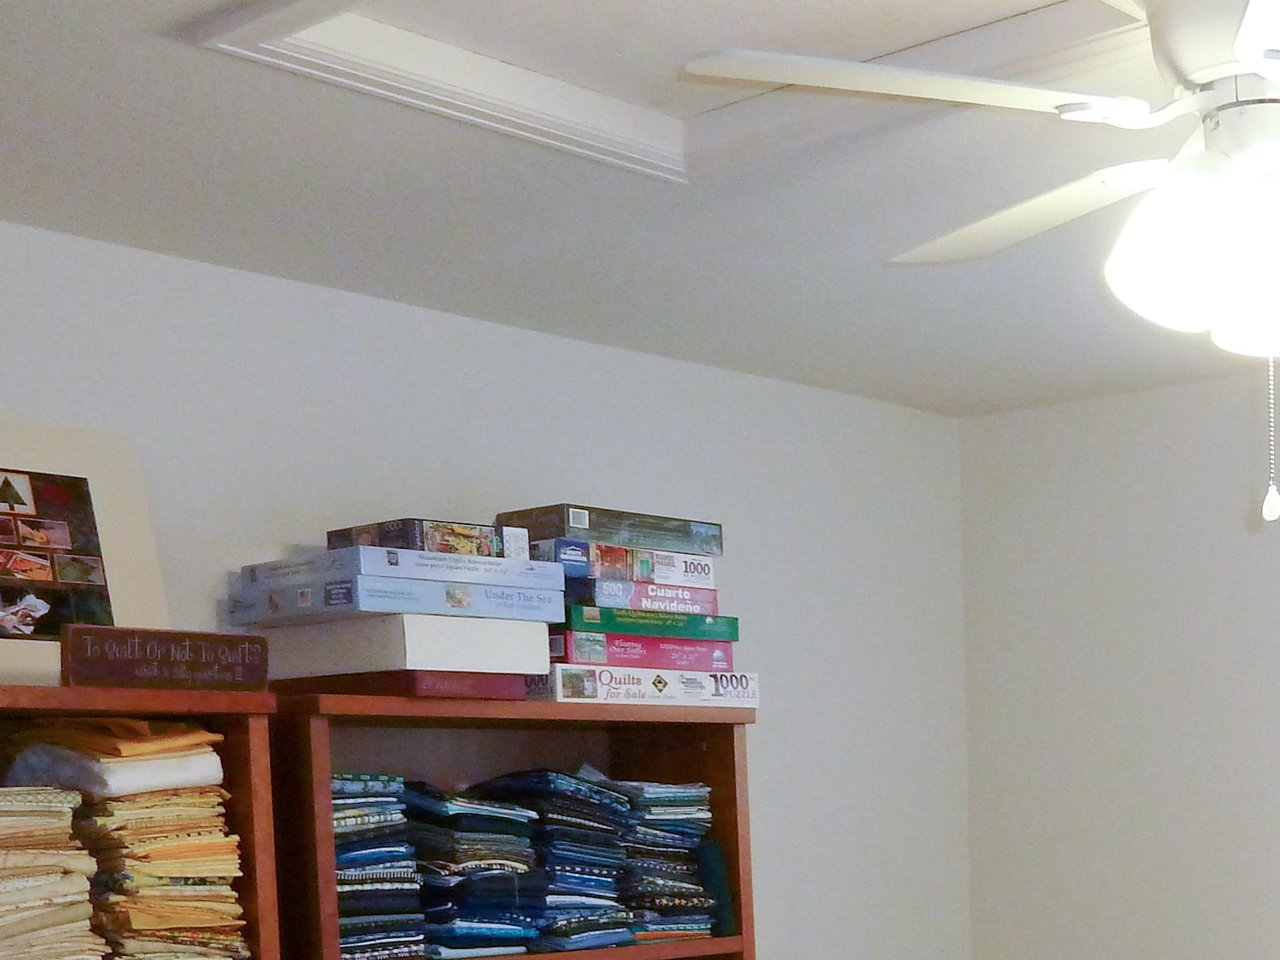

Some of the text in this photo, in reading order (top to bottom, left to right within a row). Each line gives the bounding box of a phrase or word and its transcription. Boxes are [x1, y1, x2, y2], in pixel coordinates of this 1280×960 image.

[683, 560, 710, 576] 1000
[602, 581, 623, 596] 500
[647, 585, 691, 599] Cuarto
[484, 589, 553, 604] Under The Sea
[641, 598, 701, 614] Navideño
[82, 635, 100, 657] To
[598, 669, 642, 690] Quilts
[709, 673, 748, 697] 1000
[604, 686, 647, 700] for Sale
[724, 688, 757, 699] PUZZLE
